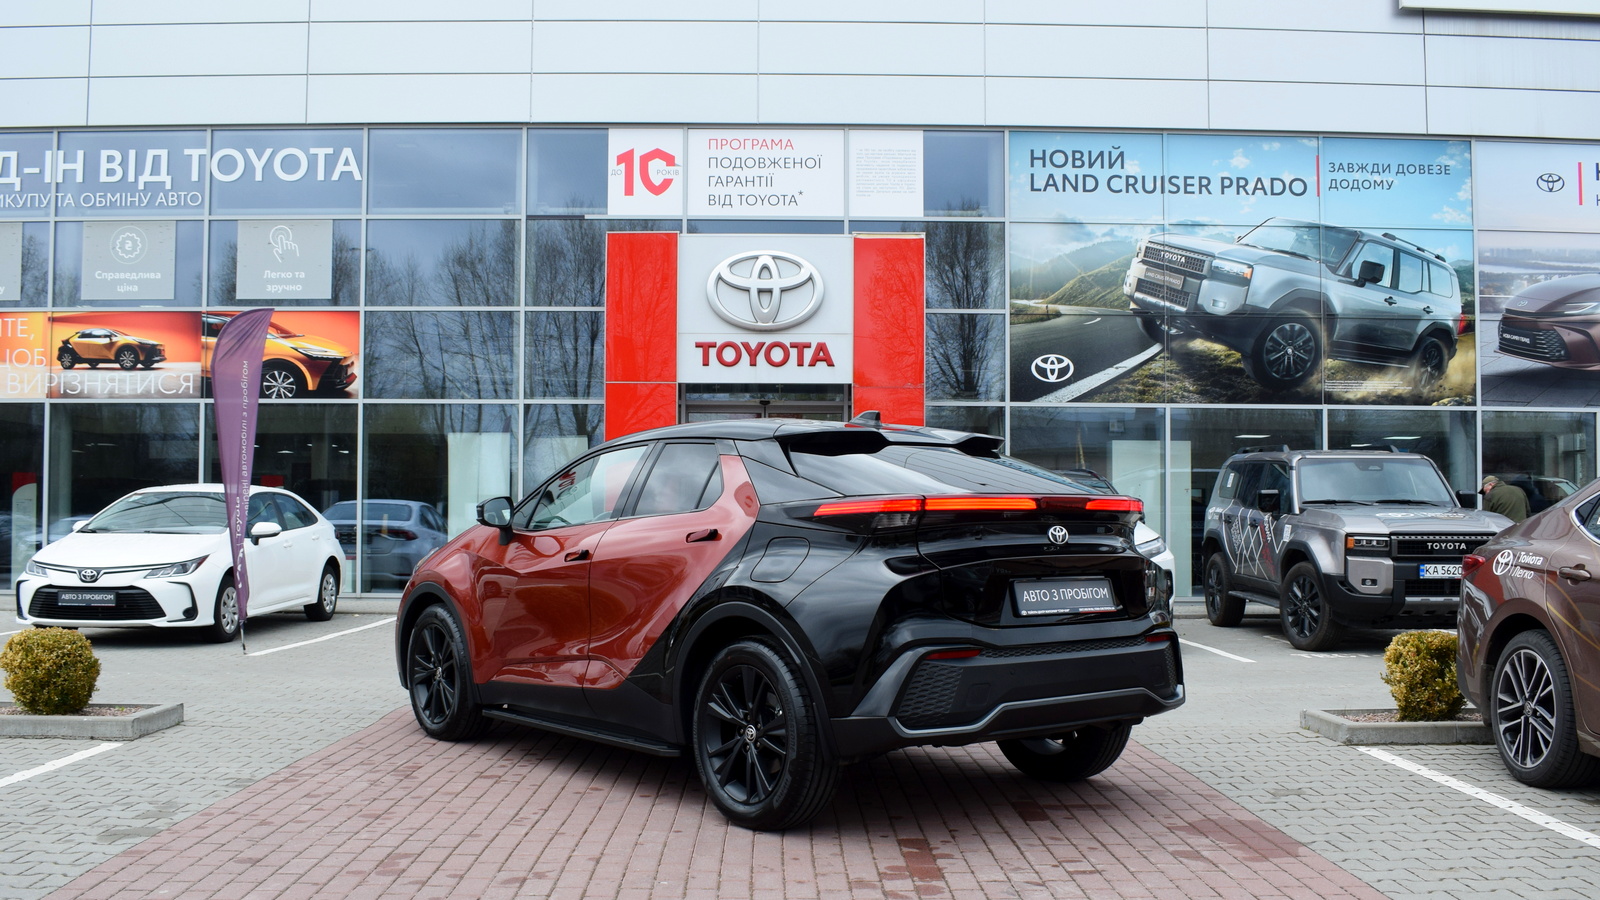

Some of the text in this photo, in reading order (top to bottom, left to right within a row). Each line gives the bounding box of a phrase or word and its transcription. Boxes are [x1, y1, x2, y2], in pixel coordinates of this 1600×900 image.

[708, 138, 794, 151] ПРОГРАМА
[708, 154, 823, 171] ПОДОВЖЕНОЇ
[1029, 147, 1125, 171] НОВИЙ
[99, 148, 172, 190] ВІД
[184, 147, 363, 183] TOYOTA
[611, 169, 622, 177] ДО
[656, 168, 680, 177] РОКІВ
[1328, 161, 1452, 177] ЗАВЖДИ ДОВЕЗЕ
[708, 172, 774, 188] ГАРАНТІЇ
[1029, 172, 1308, 198] LAND CRUISER PRADO
[1328, 177, 1394, 193] ДОДОМУ
[54, 193, 75, 207] ТА
[80, 192, 151, 208] ОБМІНУ
[155, 191, 202, 207] АВТО
[708, 194, 733, 209] ВІД
[1160, 252, 1186, 262] TOYOTA
[95, 270, 162, 281] Справедлива
[263, 270, 305, 280] Легко та
[116, 283, 138, 294] ціна
[266, 283, 303, 293] зручно
[695, 341, 835, 369] TOYOTA
[7, 373, 194, 395] ВИРІЗНЯТИСЯ
[241, 360, 249, 409] пробігом
[240, 420, 249, 477] автомобілі
[1427, 542, 1467, 550] TOYOTA
[1518, 551, 1543, 565] Тойота
[1425, 567, 1463, 576] KA 5620
[1511, 567, 1534, 580] Легко
[1023, 587, 1109, 602] АВТО З ПРОБІГОМ
